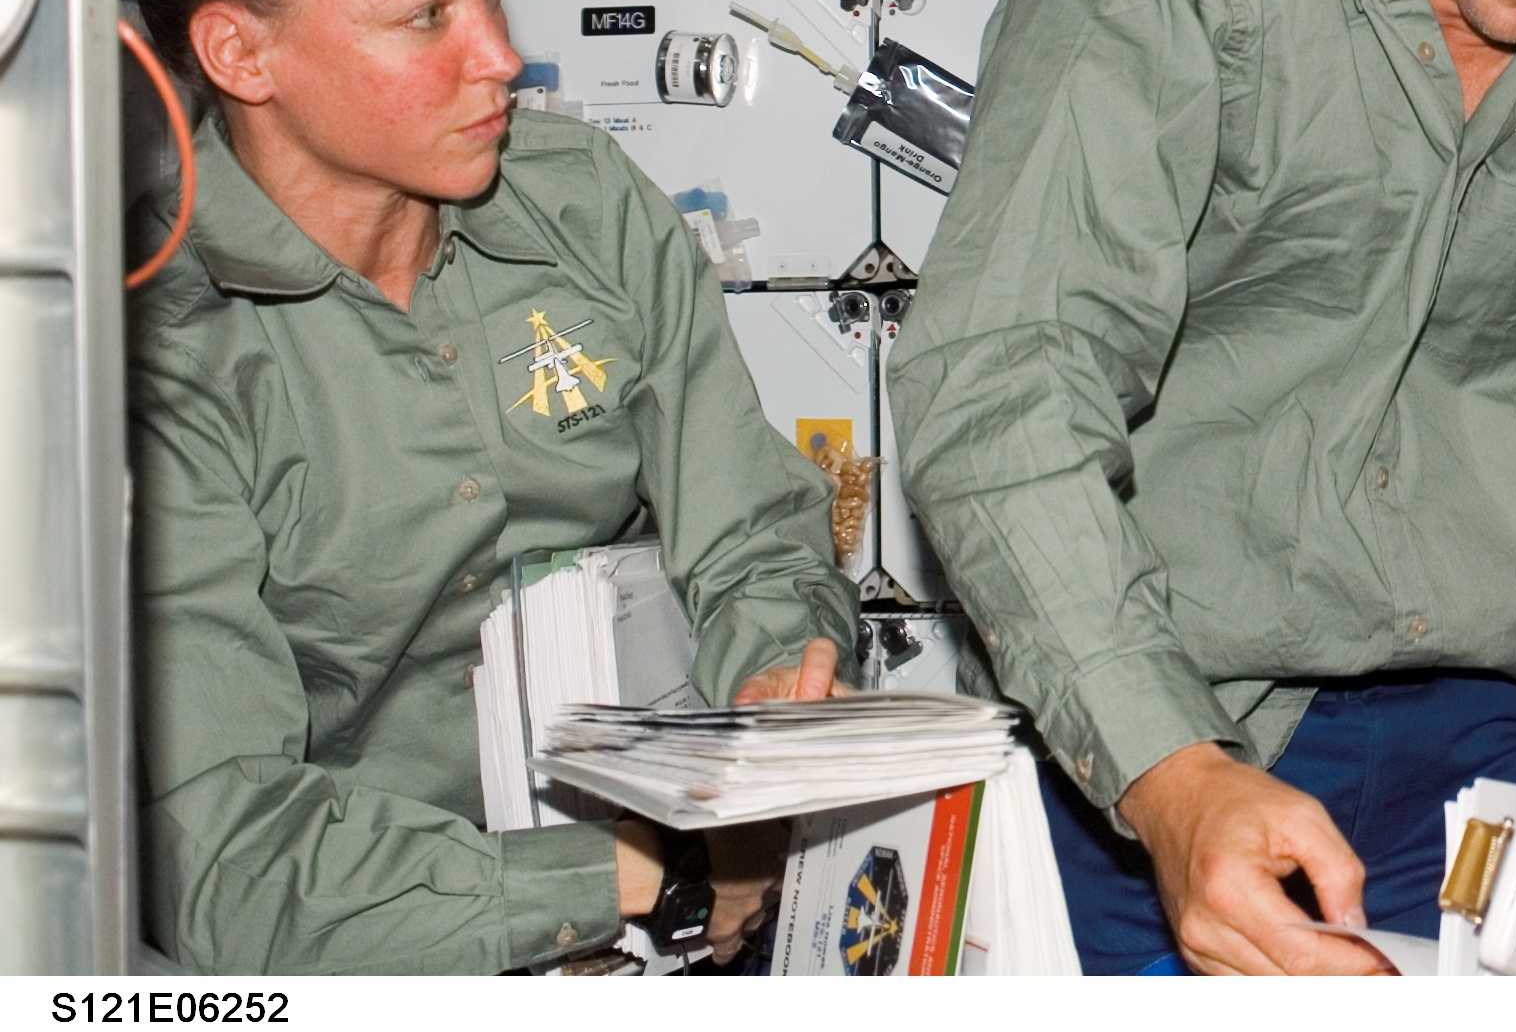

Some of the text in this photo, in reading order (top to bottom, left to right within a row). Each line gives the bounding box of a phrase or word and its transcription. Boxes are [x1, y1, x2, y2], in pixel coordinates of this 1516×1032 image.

[591, 12, 646, 30] MF14G
[873, 141, 942, 182] Orange-Mango
[899, 144, 925, 163] Drink
[557, 404, 606, 433] STS-121
[795, 838, 807, 884] CREW
[941, 815, 957, 870] NATIONAL
[934, 844, 946, 881] SPACE
